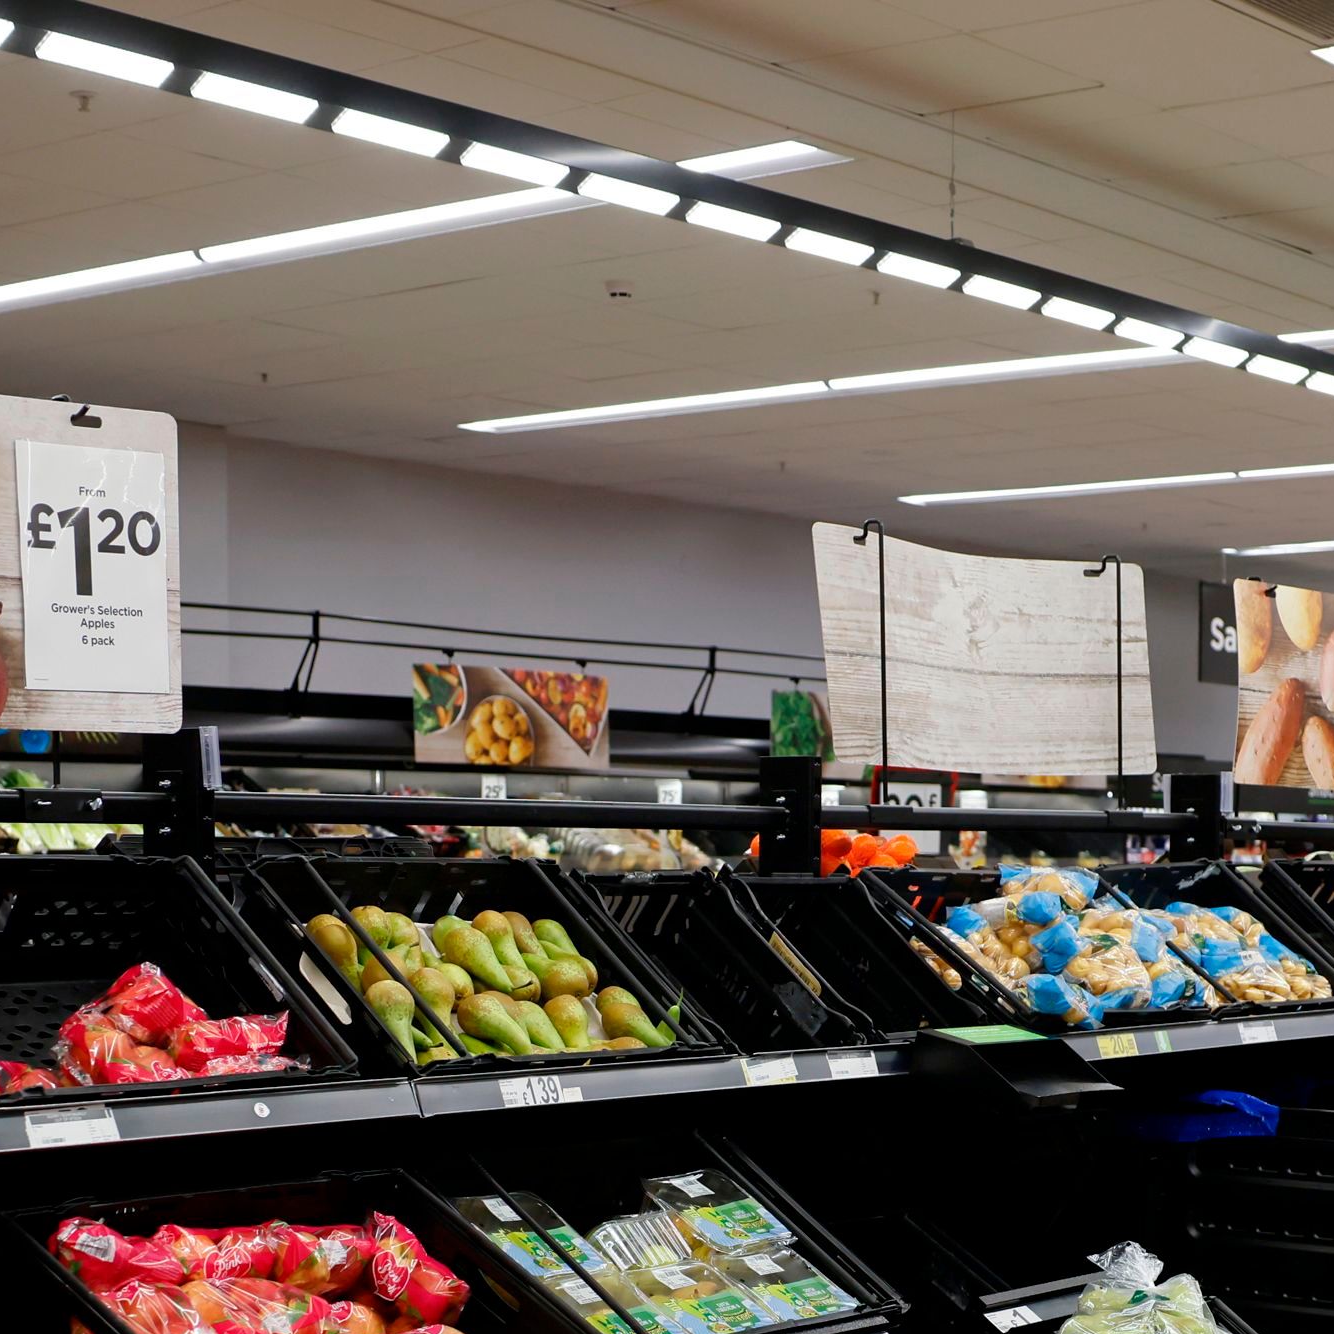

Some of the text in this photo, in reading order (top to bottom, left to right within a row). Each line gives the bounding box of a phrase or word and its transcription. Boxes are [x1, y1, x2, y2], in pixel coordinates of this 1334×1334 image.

[78, 487, 106, 498] From
[50, 603, 143, 617] Grower's Selection
[80, 617, 115, 629] Apples
[81, 635, 115, 647] 6 pack
